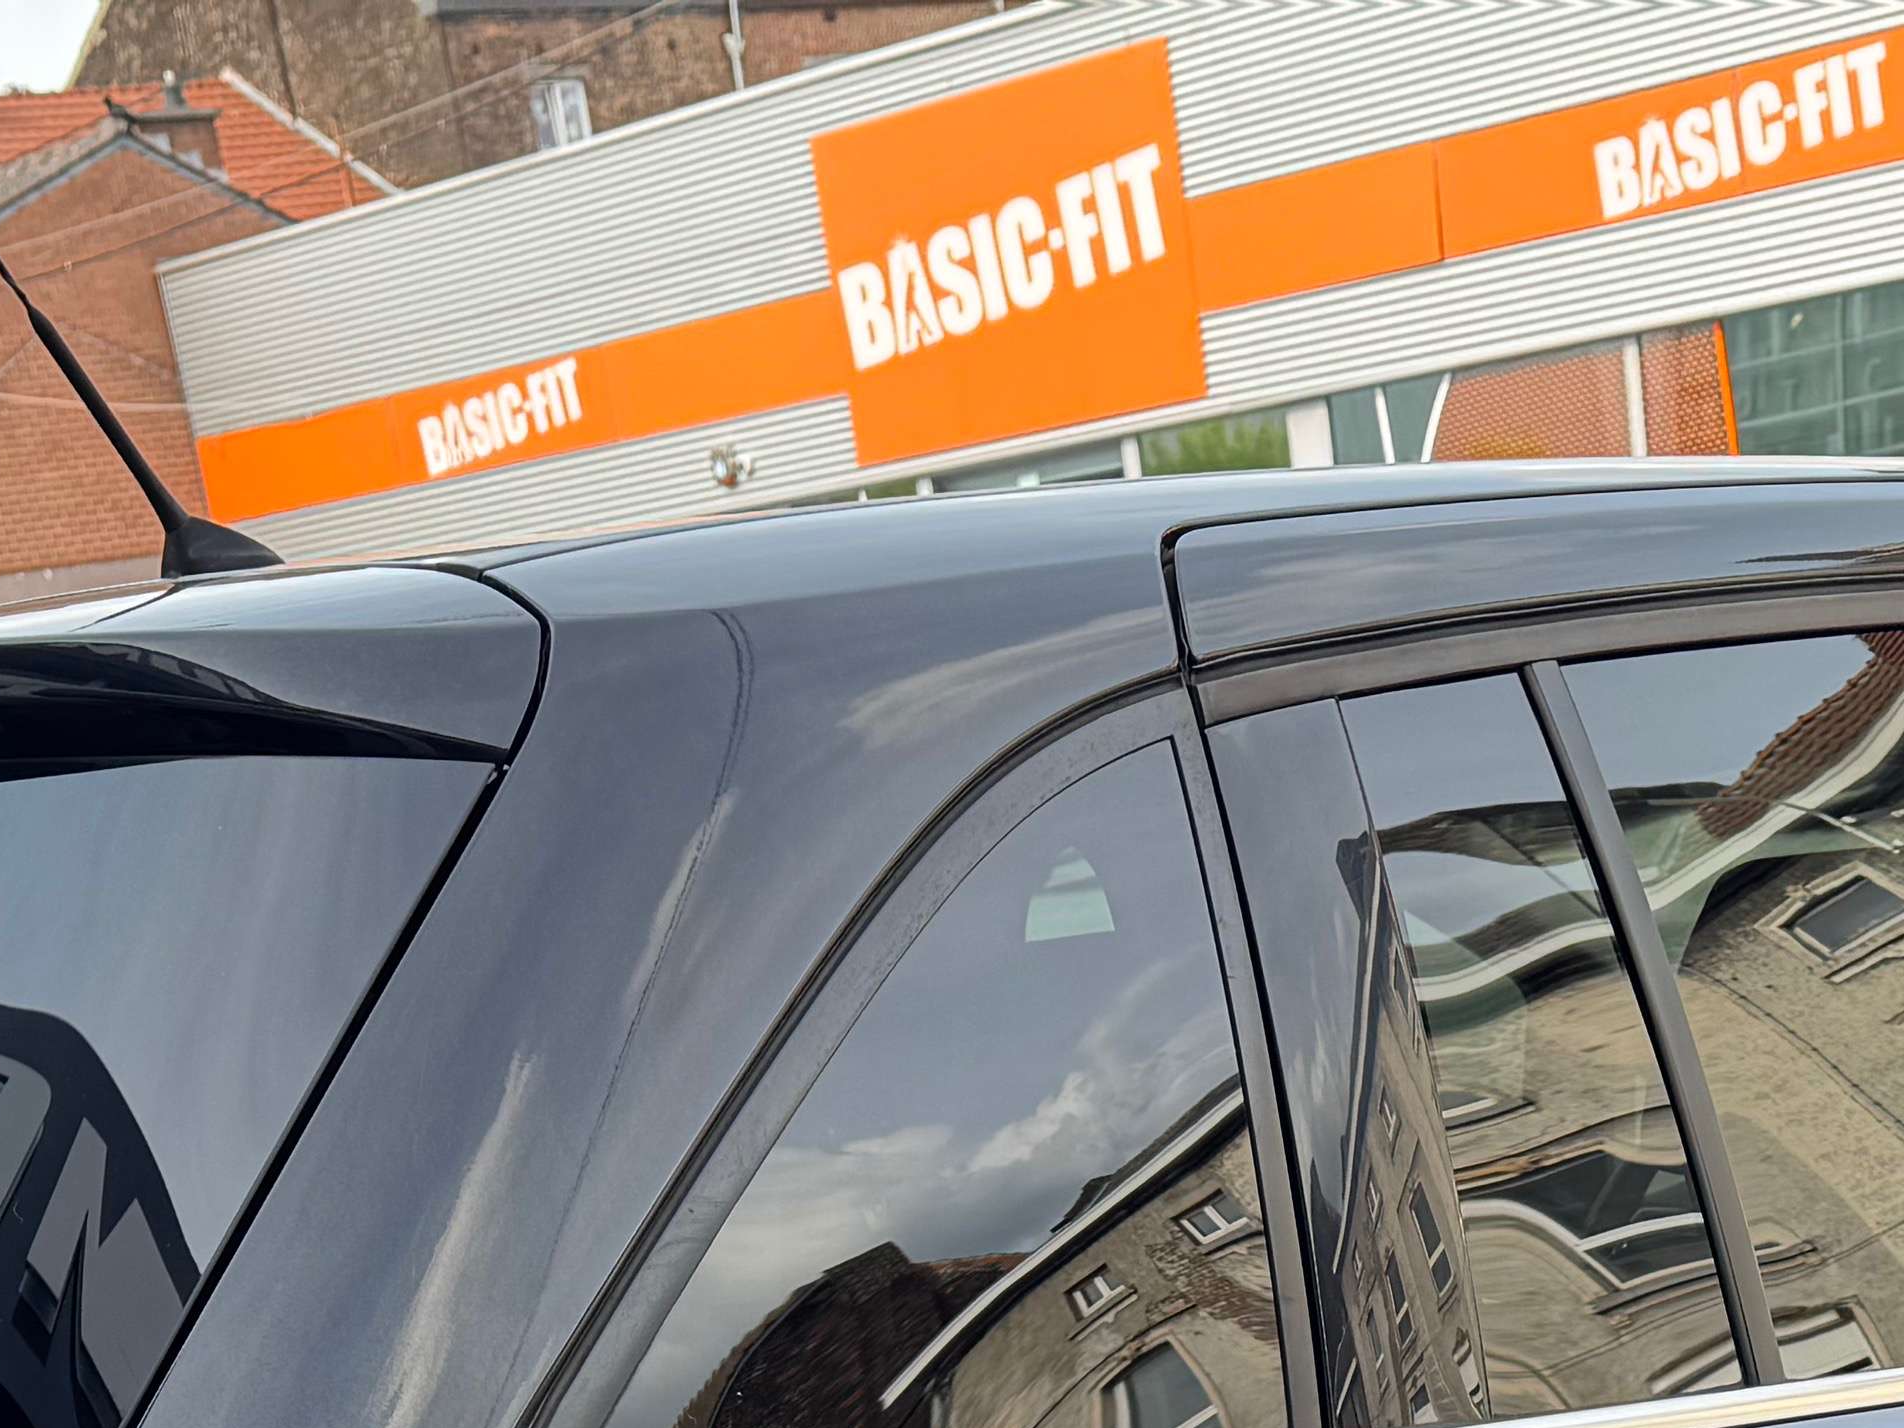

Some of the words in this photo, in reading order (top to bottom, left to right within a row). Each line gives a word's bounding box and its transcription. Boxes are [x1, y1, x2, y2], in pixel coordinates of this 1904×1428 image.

[1593, 41, 1887, 219] BASIC-FIT
[837, 143, 1166, 373] BASIC-FIT
[417, 356, 583, 478] BASIC-FIT
